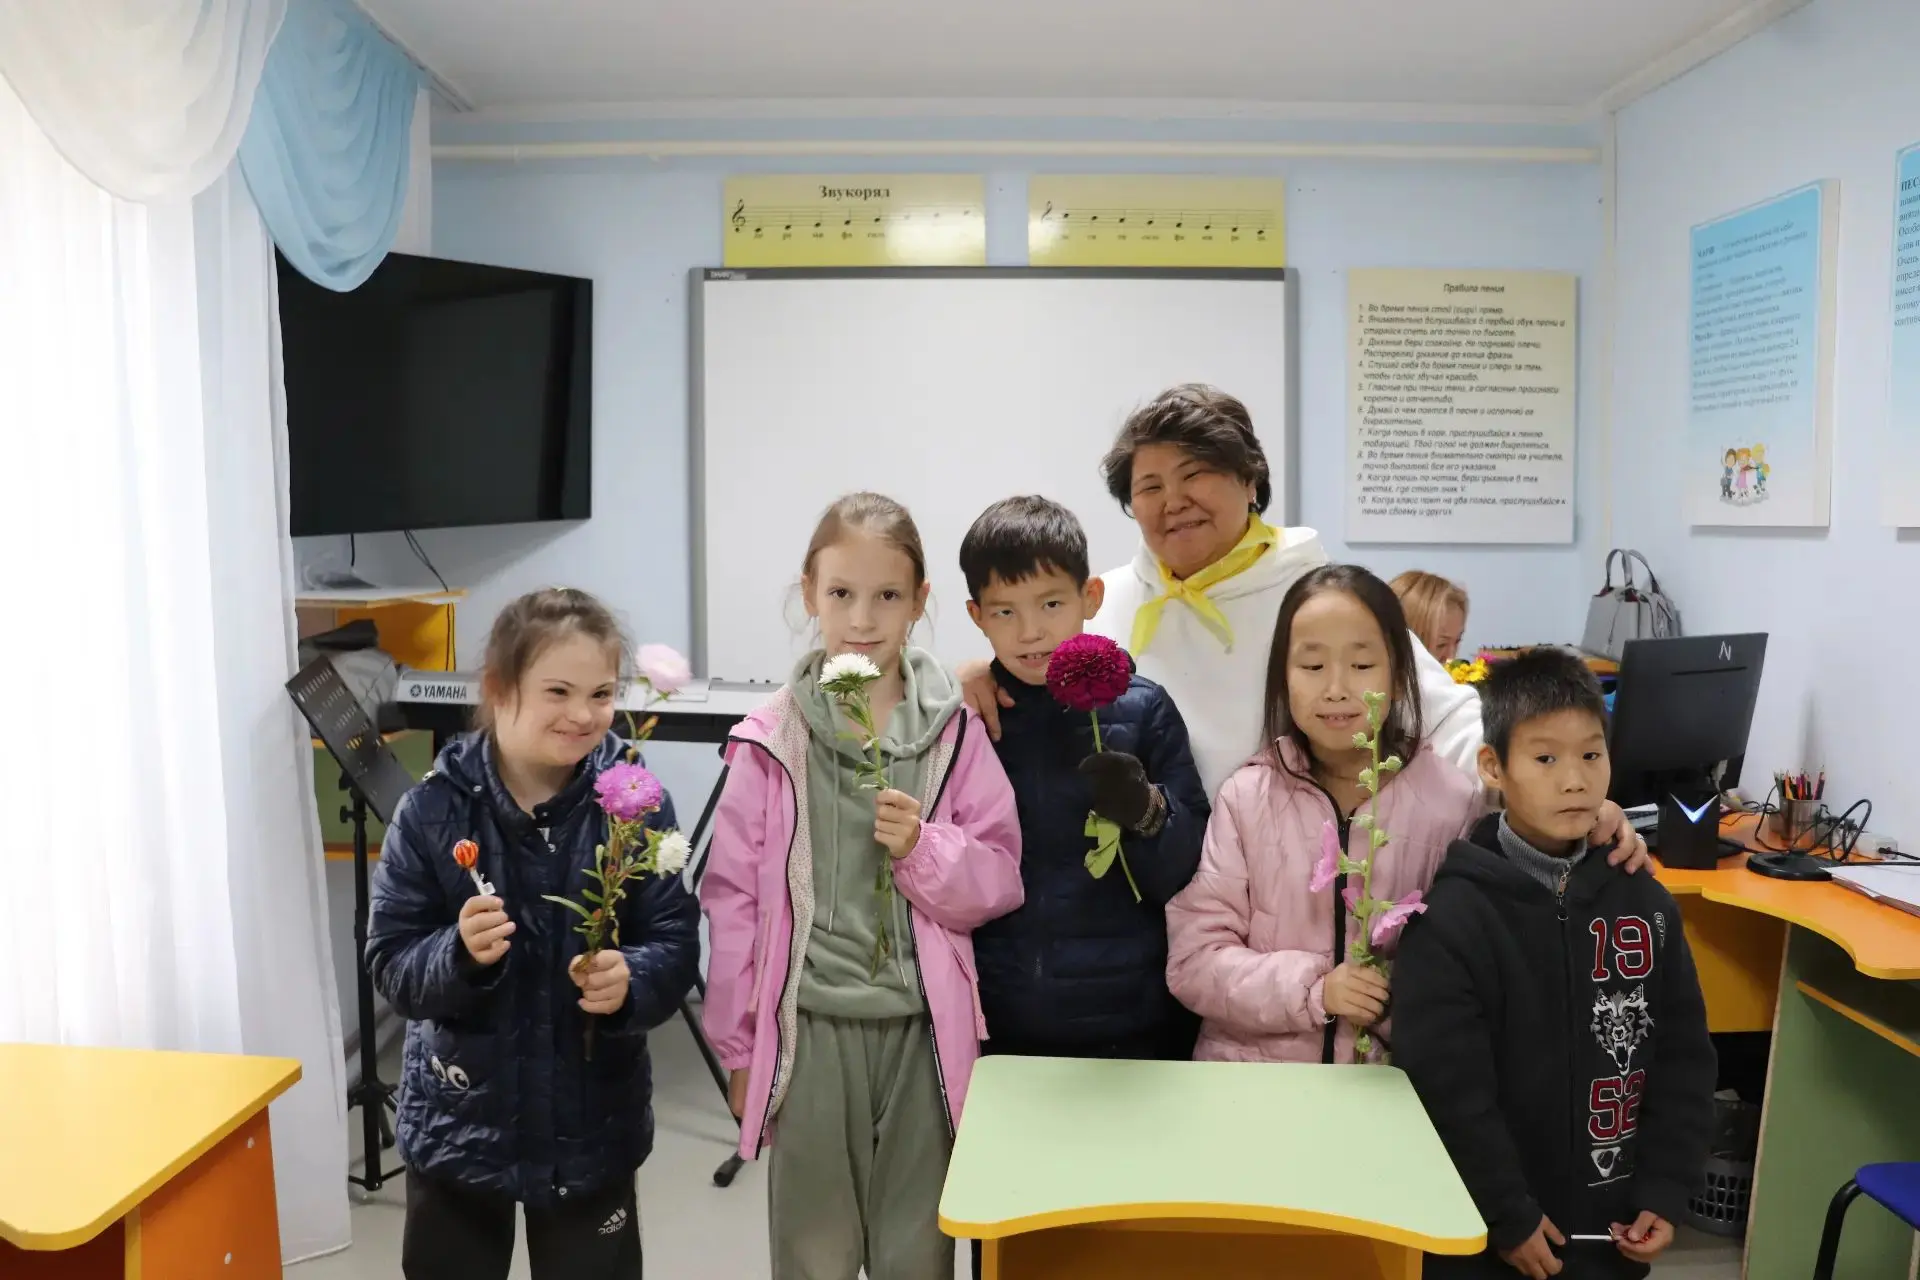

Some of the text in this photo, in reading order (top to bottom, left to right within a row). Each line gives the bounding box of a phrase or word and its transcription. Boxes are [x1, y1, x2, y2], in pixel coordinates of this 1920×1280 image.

[819, 185, 890, 201] Звукоряд
[423, 685, 467, 699] YAMAHA
[1588, 915, 1653, 981] 19
